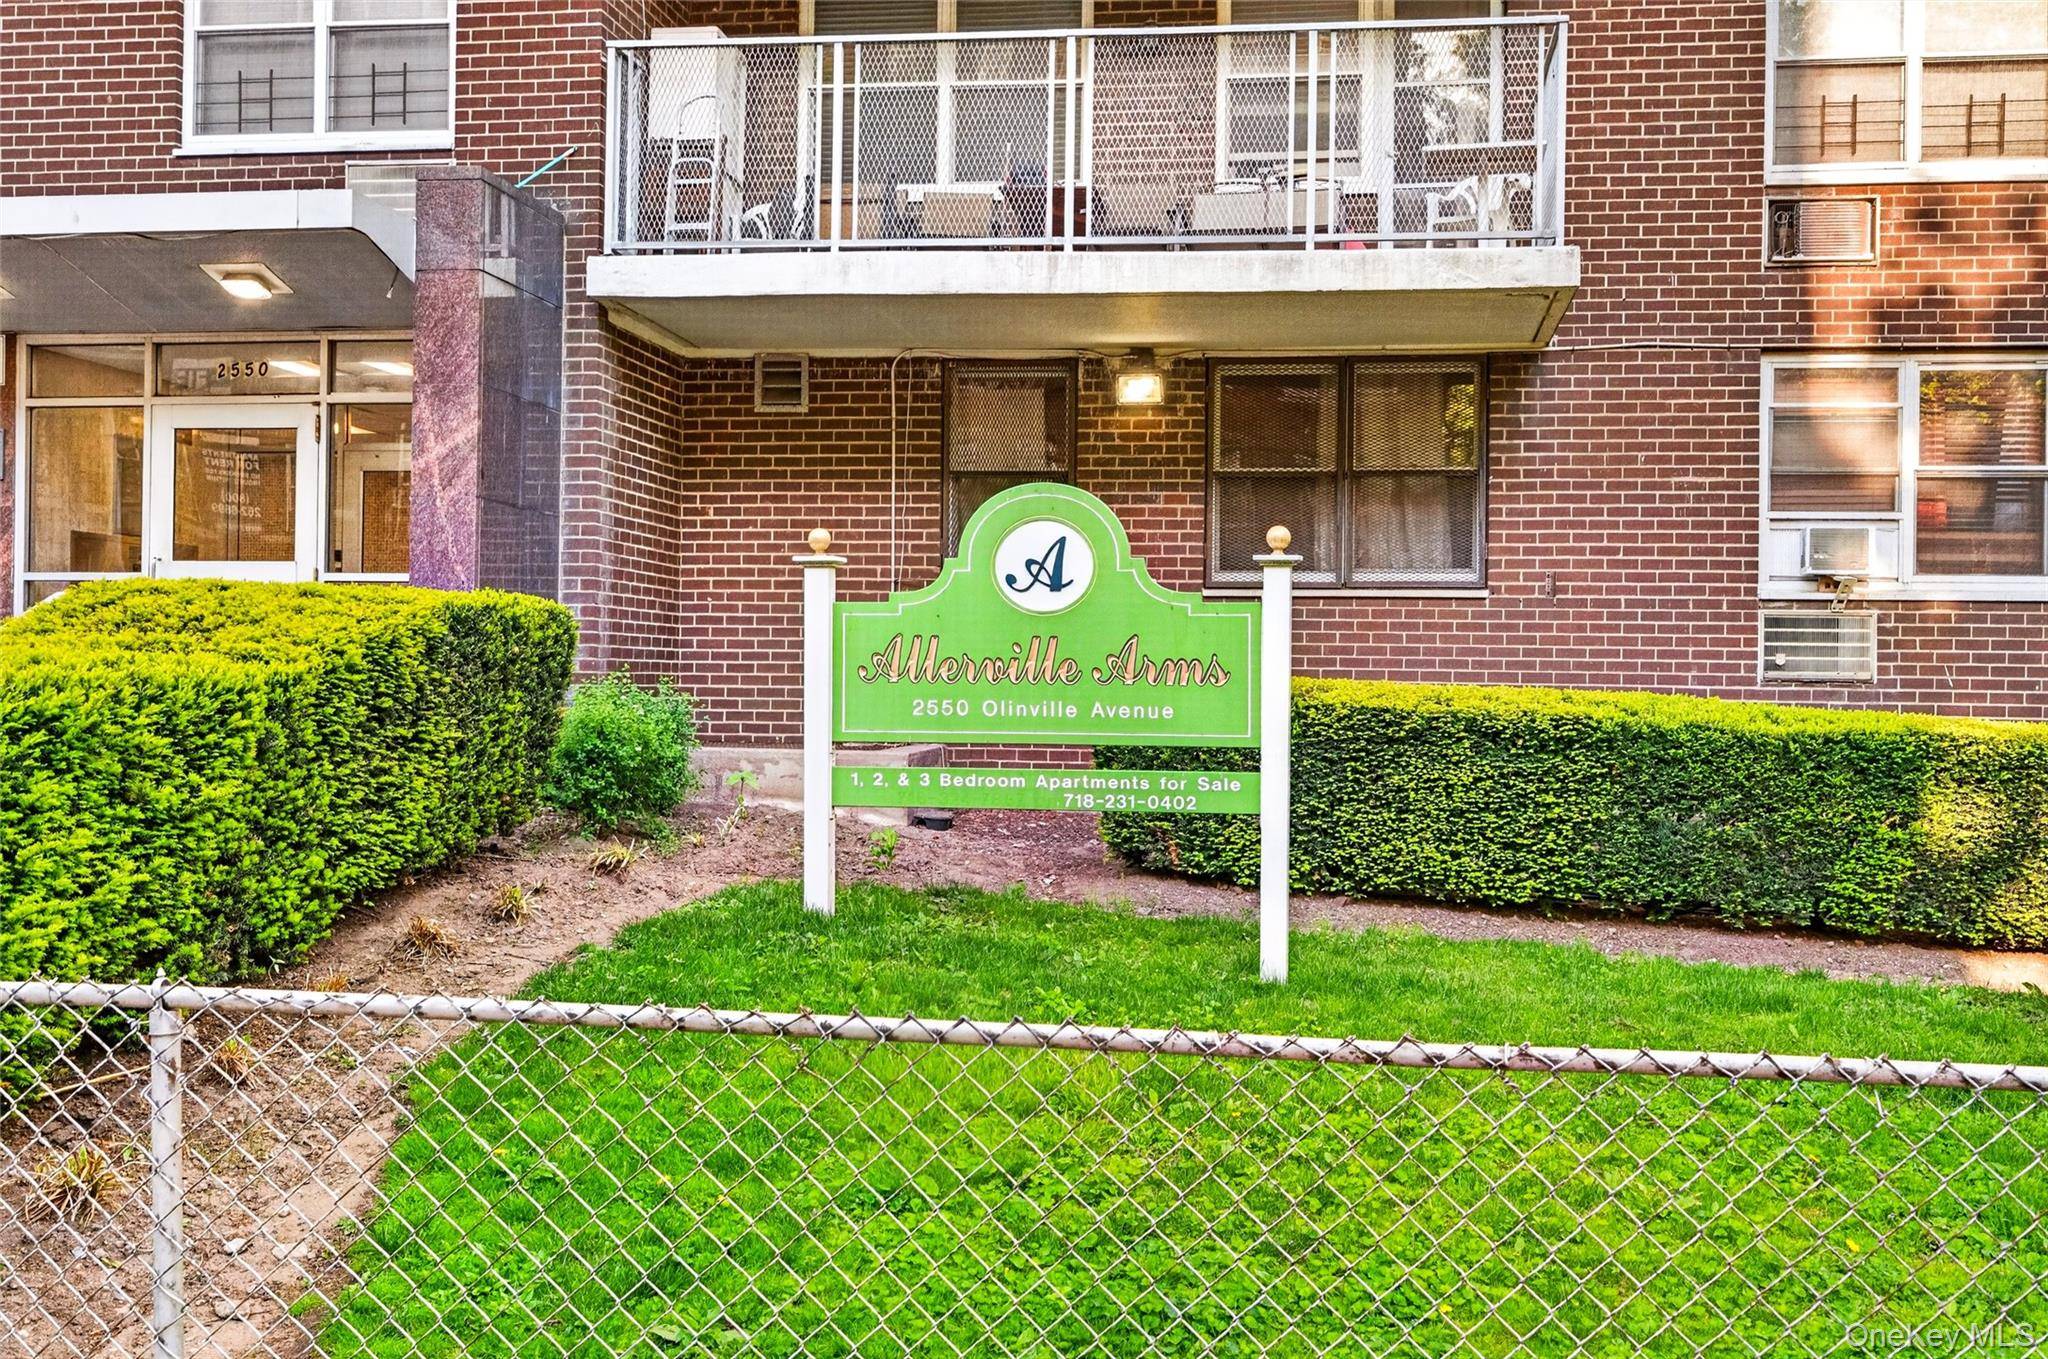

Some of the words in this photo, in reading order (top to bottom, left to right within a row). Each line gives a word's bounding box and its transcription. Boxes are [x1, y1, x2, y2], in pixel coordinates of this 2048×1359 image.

[217, 361, 268, 379] 2550
[1004, 535, 1074, 593] A
[857, 634, 1082, 686] Allerville
[1093, 634, 1231, 687] Arms
[912, 699, 969, 717] 2550
[982, 700, 1078, 719] Olinville
[1091, 701, 1174, 719] Avenue
[850, 772, 864, 787] 1,
[872, 772, 889, 788] 2,
[897, 773, 909, 787] &
[919, 773, 930, 787] 3
[939, 773, 1026, 789] Bedroom
[1035, 774, 1150, 792] Apartments
[1160, 777, 1188, 791] for
[1197, 777, 1241, 792] Sale
[1063, 793, 1197, 811] 718-231-0402
